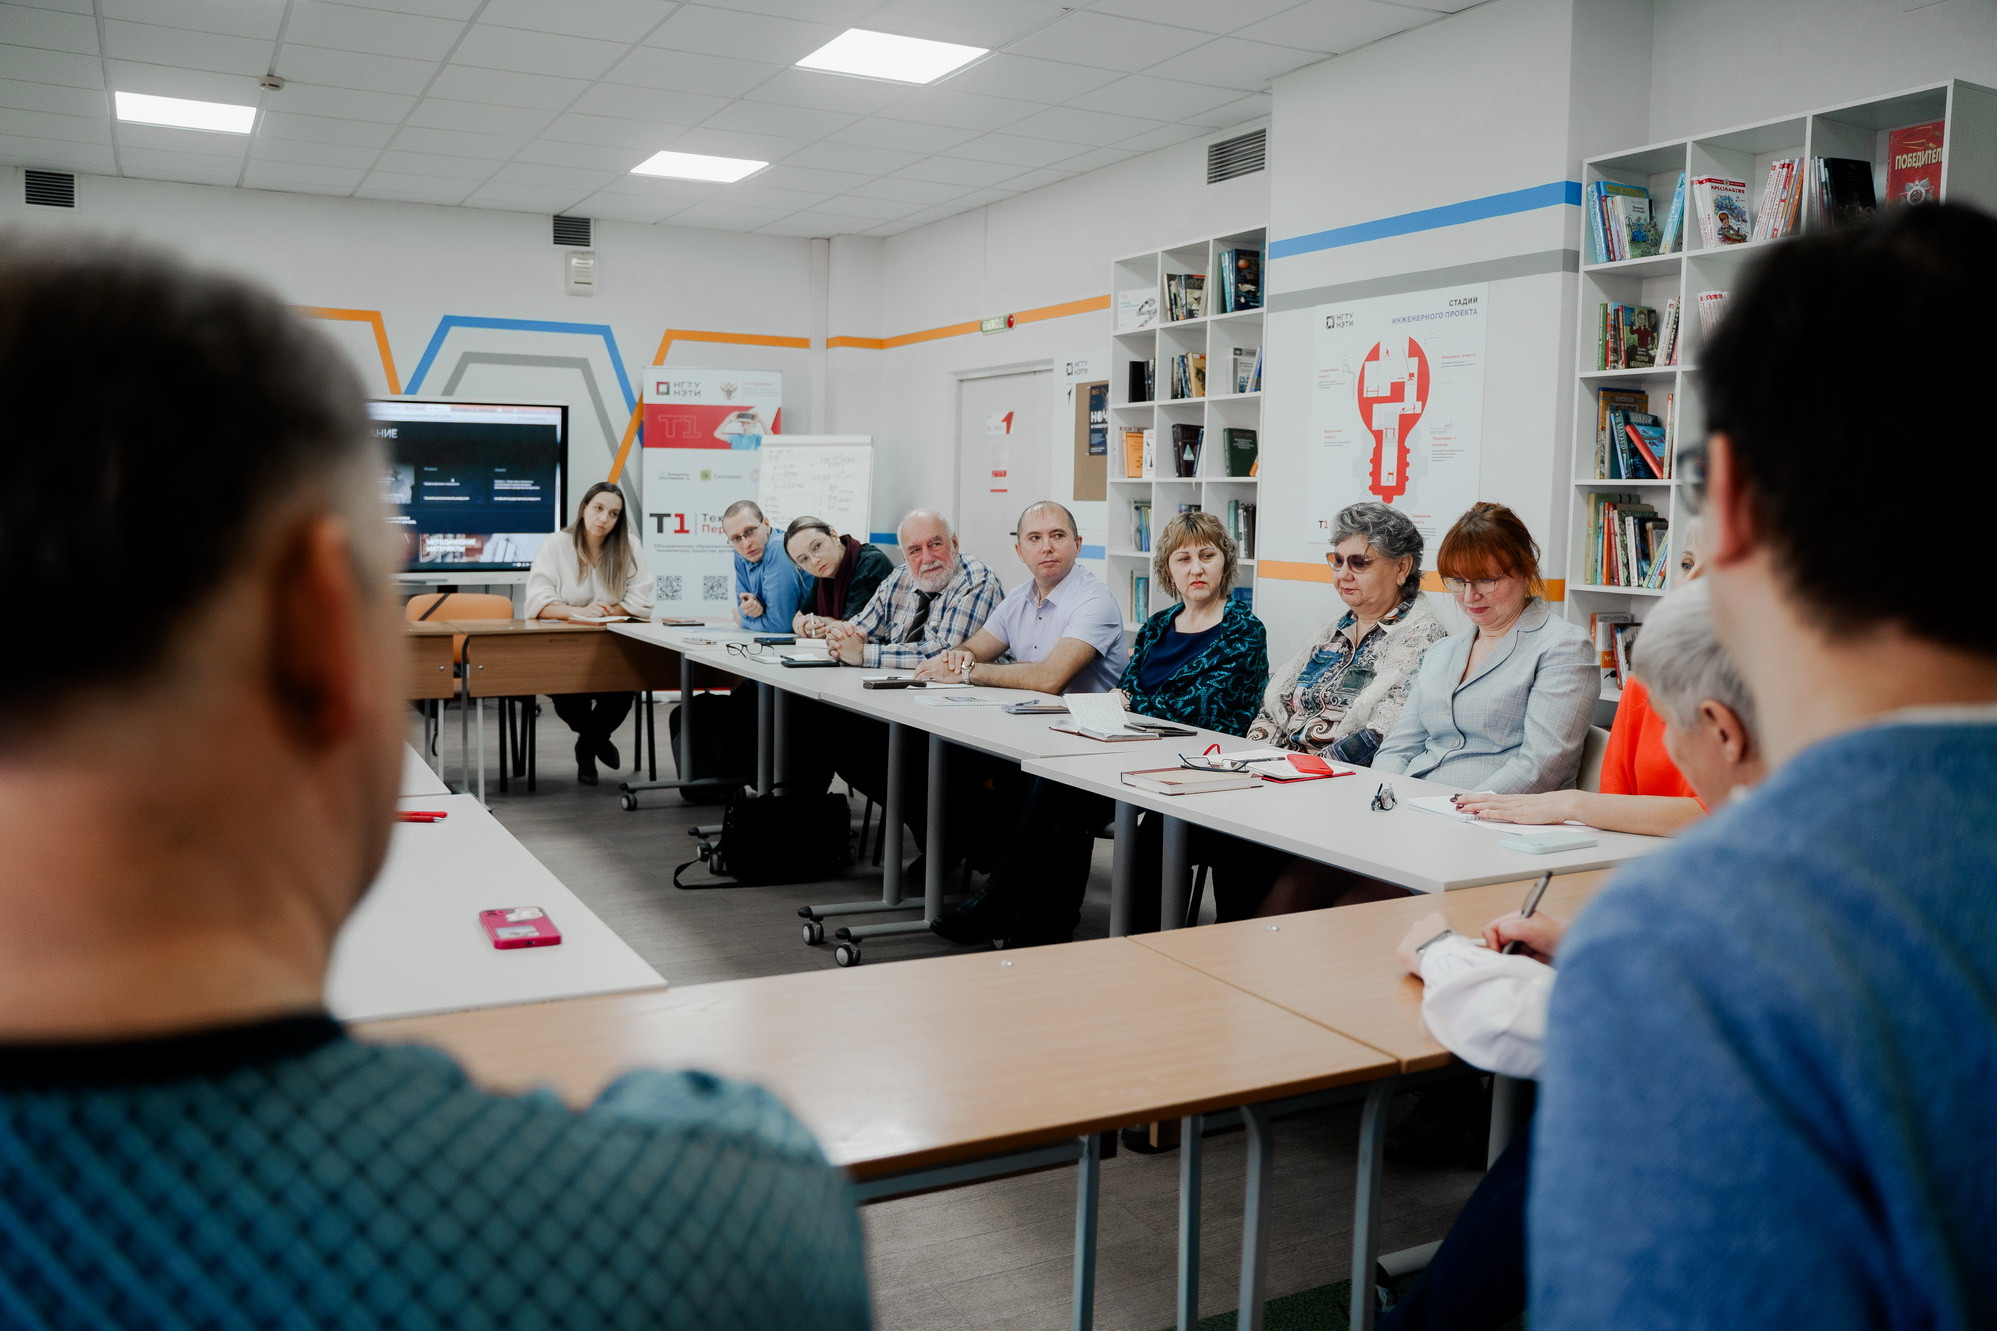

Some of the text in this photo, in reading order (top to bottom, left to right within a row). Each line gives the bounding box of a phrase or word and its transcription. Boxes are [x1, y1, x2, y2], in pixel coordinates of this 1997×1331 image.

[1448, 297, 1478, 307] СТАДИИ
[1336, 313, 1354, 321] НГТУ
[1391, 308, 1478, 325] ИНЖЕНЕРНОГО ПРОЕКТА
[702, 513, 723, 522] Тех
[649, 513, 690, 534] Т1
[702, 524, 724, 535] Пер
